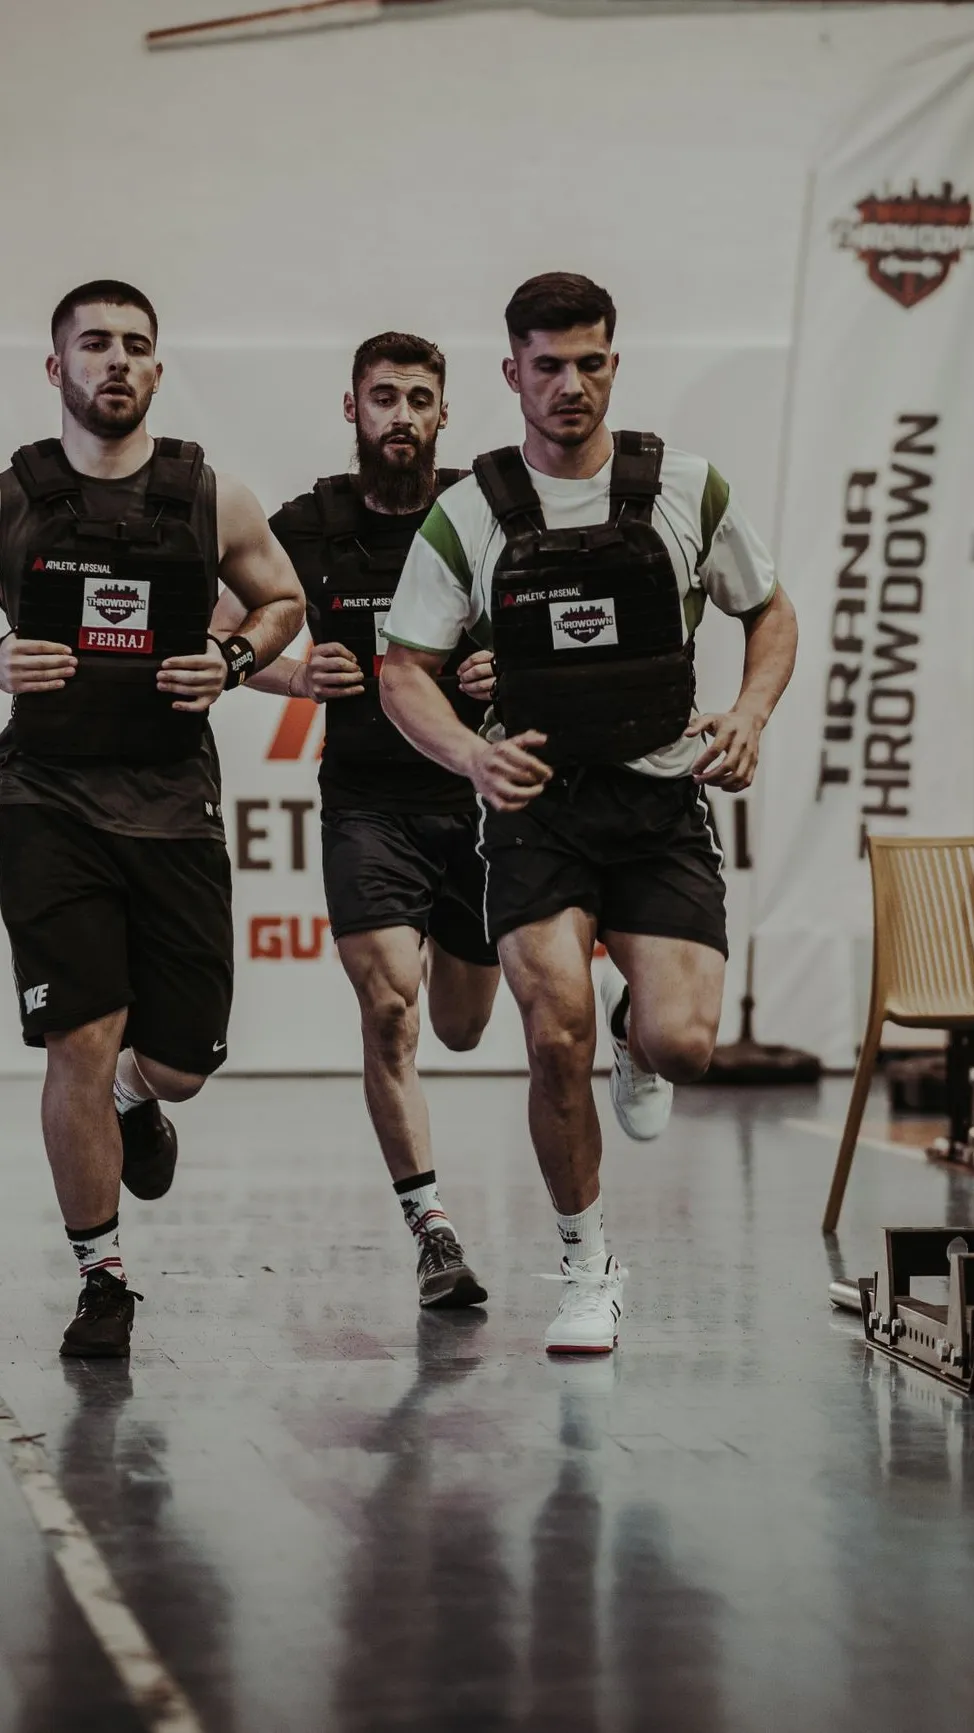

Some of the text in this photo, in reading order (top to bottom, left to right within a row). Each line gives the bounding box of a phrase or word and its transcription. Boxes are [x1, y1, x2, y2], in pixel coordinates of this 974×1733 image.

[45, 560, 112, 574] ATHLETIC ARSENAL
[515, 587, 581, 603] ATHLETIC ARSENAL
[87, 597, 146, 610] THROWDOWN
[342, 598, 370, 608] ATHLETIC
[554, 616, 613, 631] THROWDOWN
[87, 631, 146, 649] FERRAJ
[814, 470, 878, 803] TIRANA
